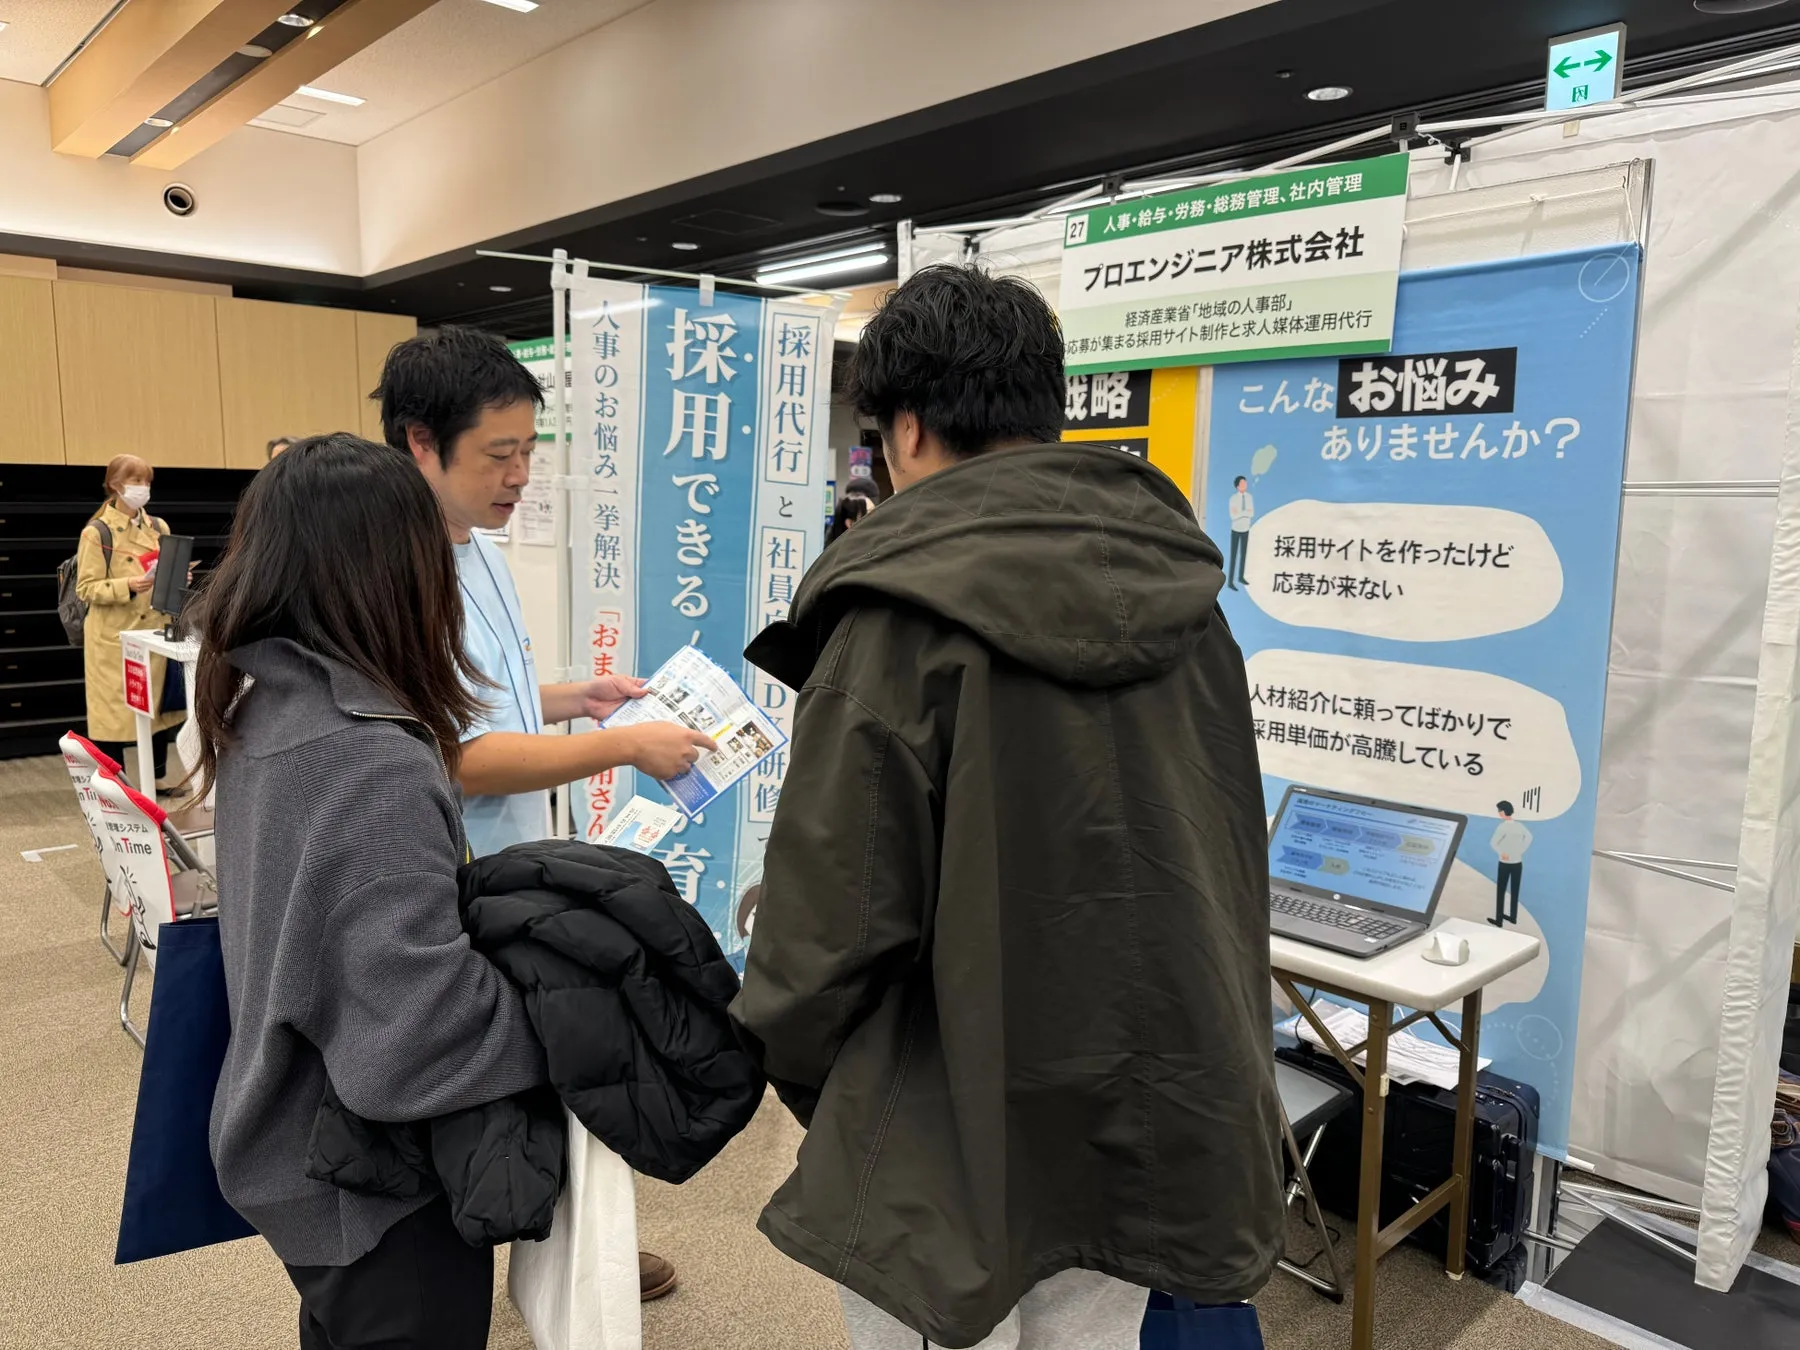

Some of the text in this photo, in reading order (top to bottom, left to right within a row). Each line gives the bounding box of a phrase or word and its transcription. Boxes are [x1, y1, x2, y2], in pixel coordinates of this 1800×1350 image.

[1103, 173, 1363, 235] 人事・給与・労務・総務管理、社内管理
[1070, 221, 1085, 239] 27
[1084, 225, 1364, 291] プロエンジニア株式会社
[1125, 293, 1293, 328] 経済産業省「地域の人事部」
[771, 323, 811, 474] 採用代行
[777, 495, 794, 518] と
[1274, 535, 1515, 569] 採用サイトを作ったけど
[1272, 571, 1404, 600] 応募が来ない
[1250, 683, 1513, 740] 人材紹介に頼ってばかりで
